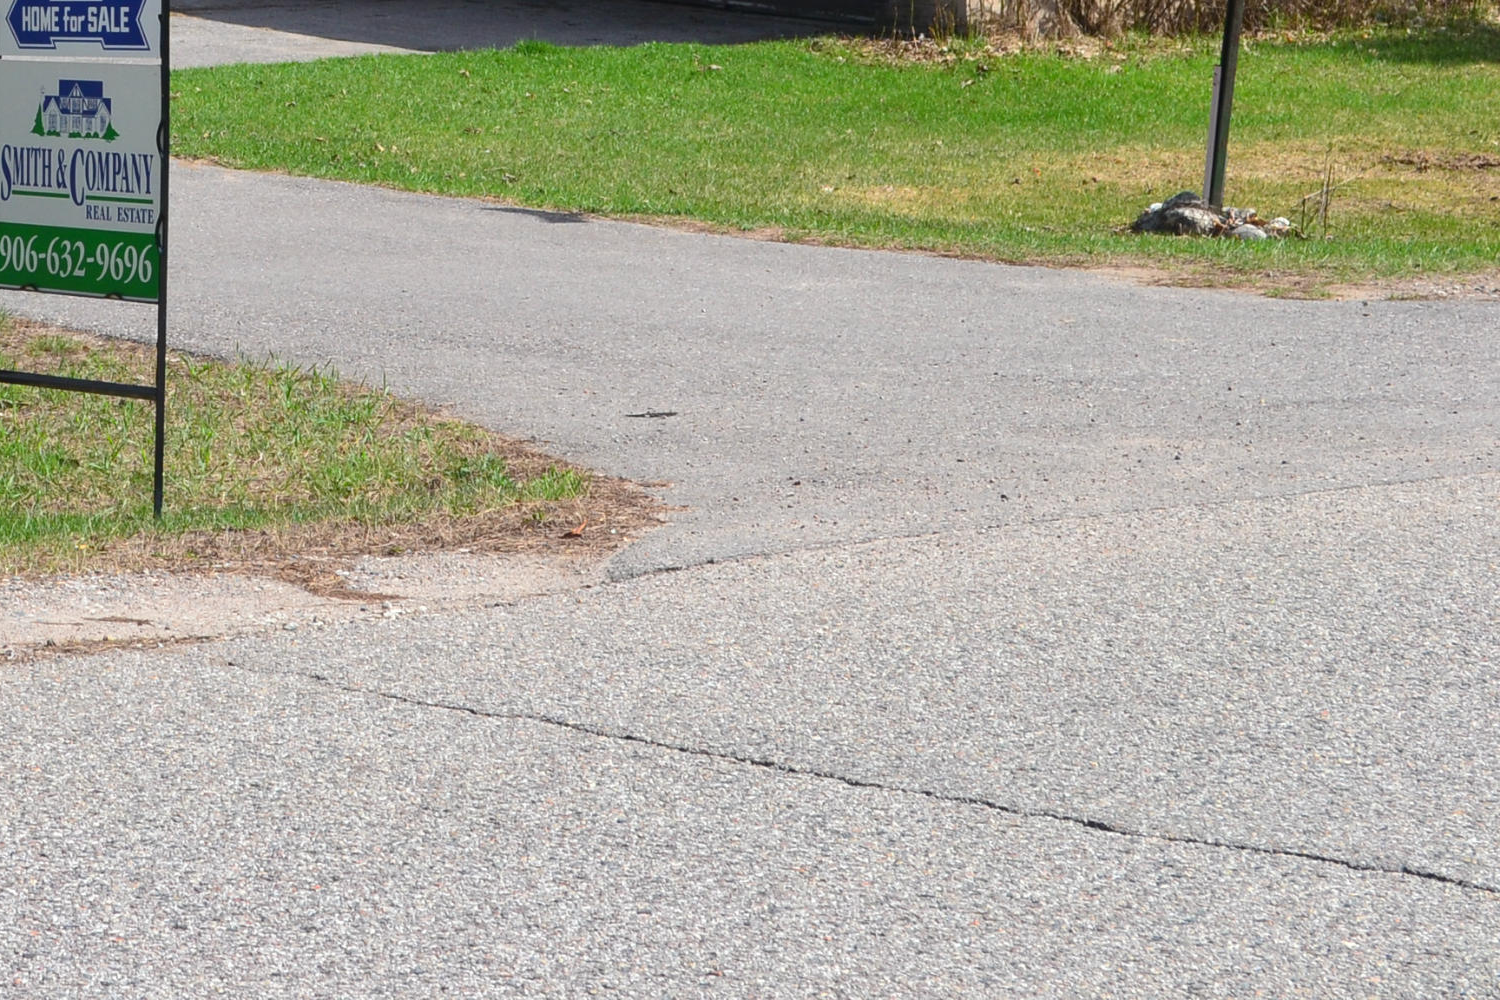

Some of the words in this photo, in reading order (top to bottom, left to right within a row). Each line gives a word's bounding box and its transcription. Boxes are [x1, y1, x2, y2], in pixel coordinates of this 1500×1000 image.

[21, 5, 60, 32] HOME
[62, 6, 85, 32] for
[87, 5, 131, 33] SALE
[0, 144, 53, 201] SMITH
[56, 148, 68, 189] &
[69, 148, 154, 206] COMPANY
[85, 205, 112, 222] REAL
[116, 207, 155, 225] ESTATE
[0, 234, 153, 284] 906-632-9696
